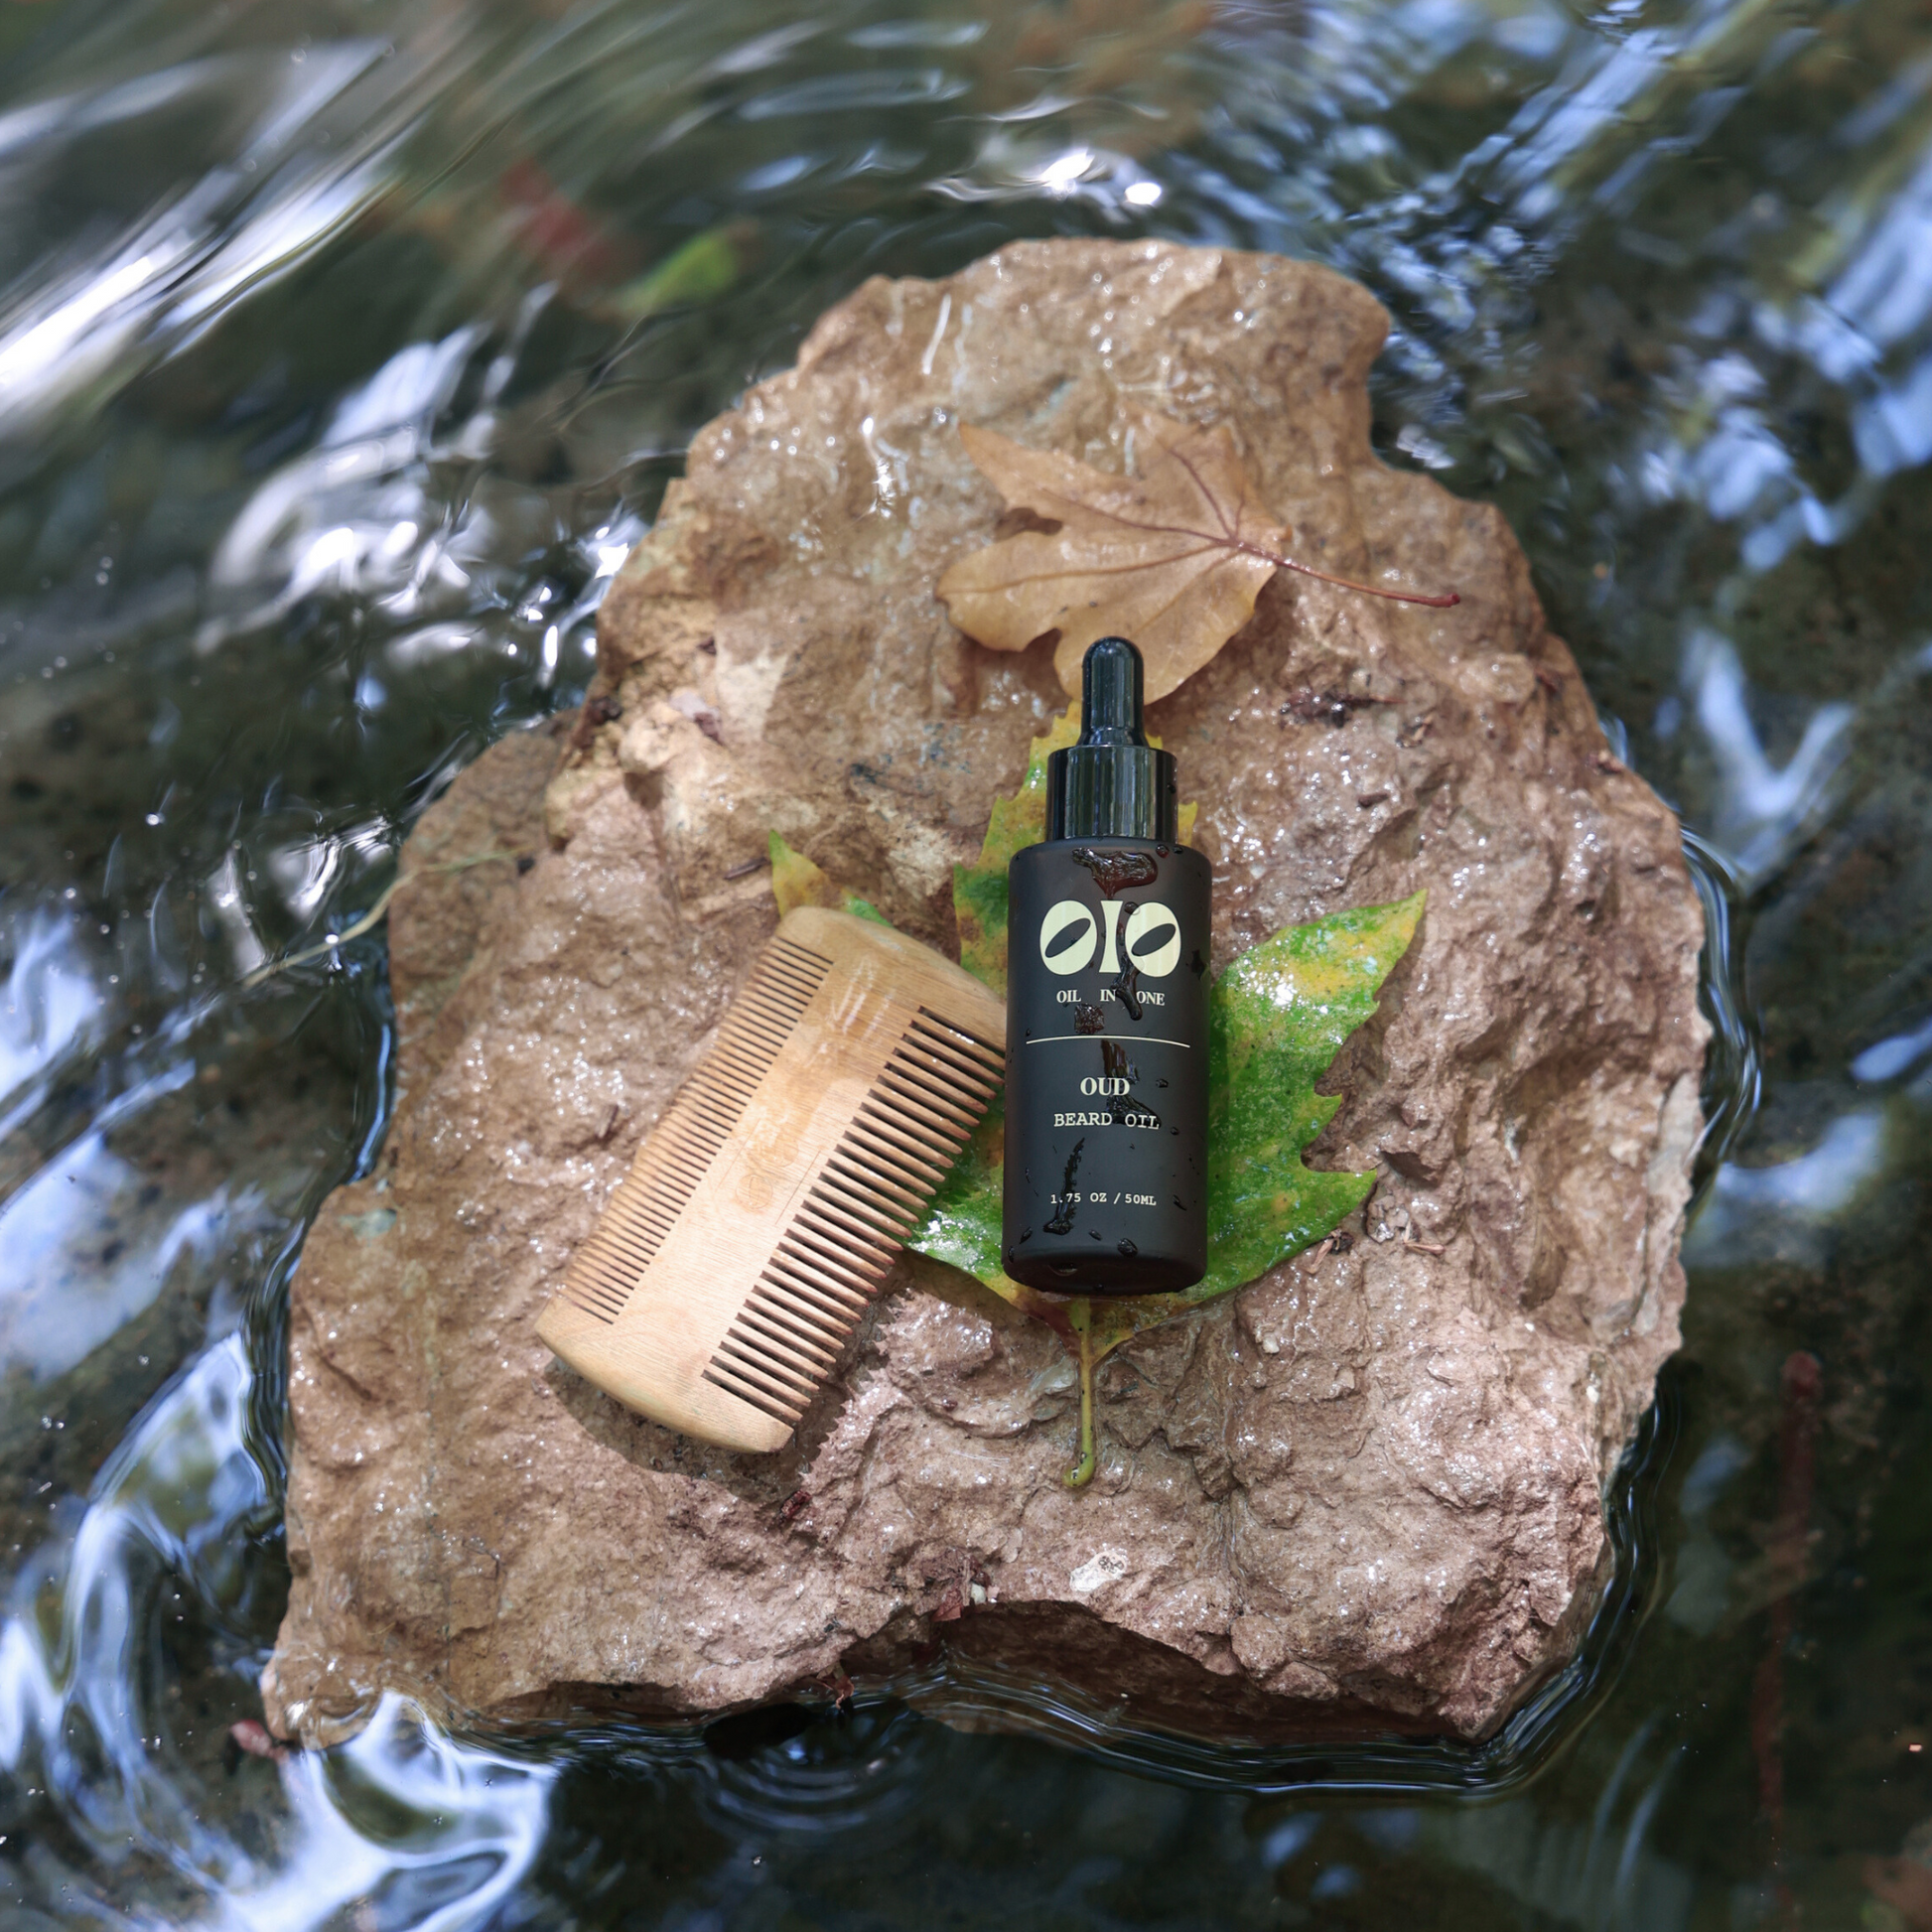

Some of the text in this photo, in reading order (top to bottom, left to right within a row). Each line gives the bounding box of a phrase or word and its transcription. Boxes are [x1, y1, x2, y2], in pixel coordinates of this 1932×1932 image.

[1056, 989, 1165, 1006] OIL IN ONE
[1080, 1077, 1130, 1095] OUD
[1053, 1112, 1160, 1130] BEARD OIL
[1050, 1193, 1081, 1204] 1.75
[1090, 1192, 1107, 1202] OZ
